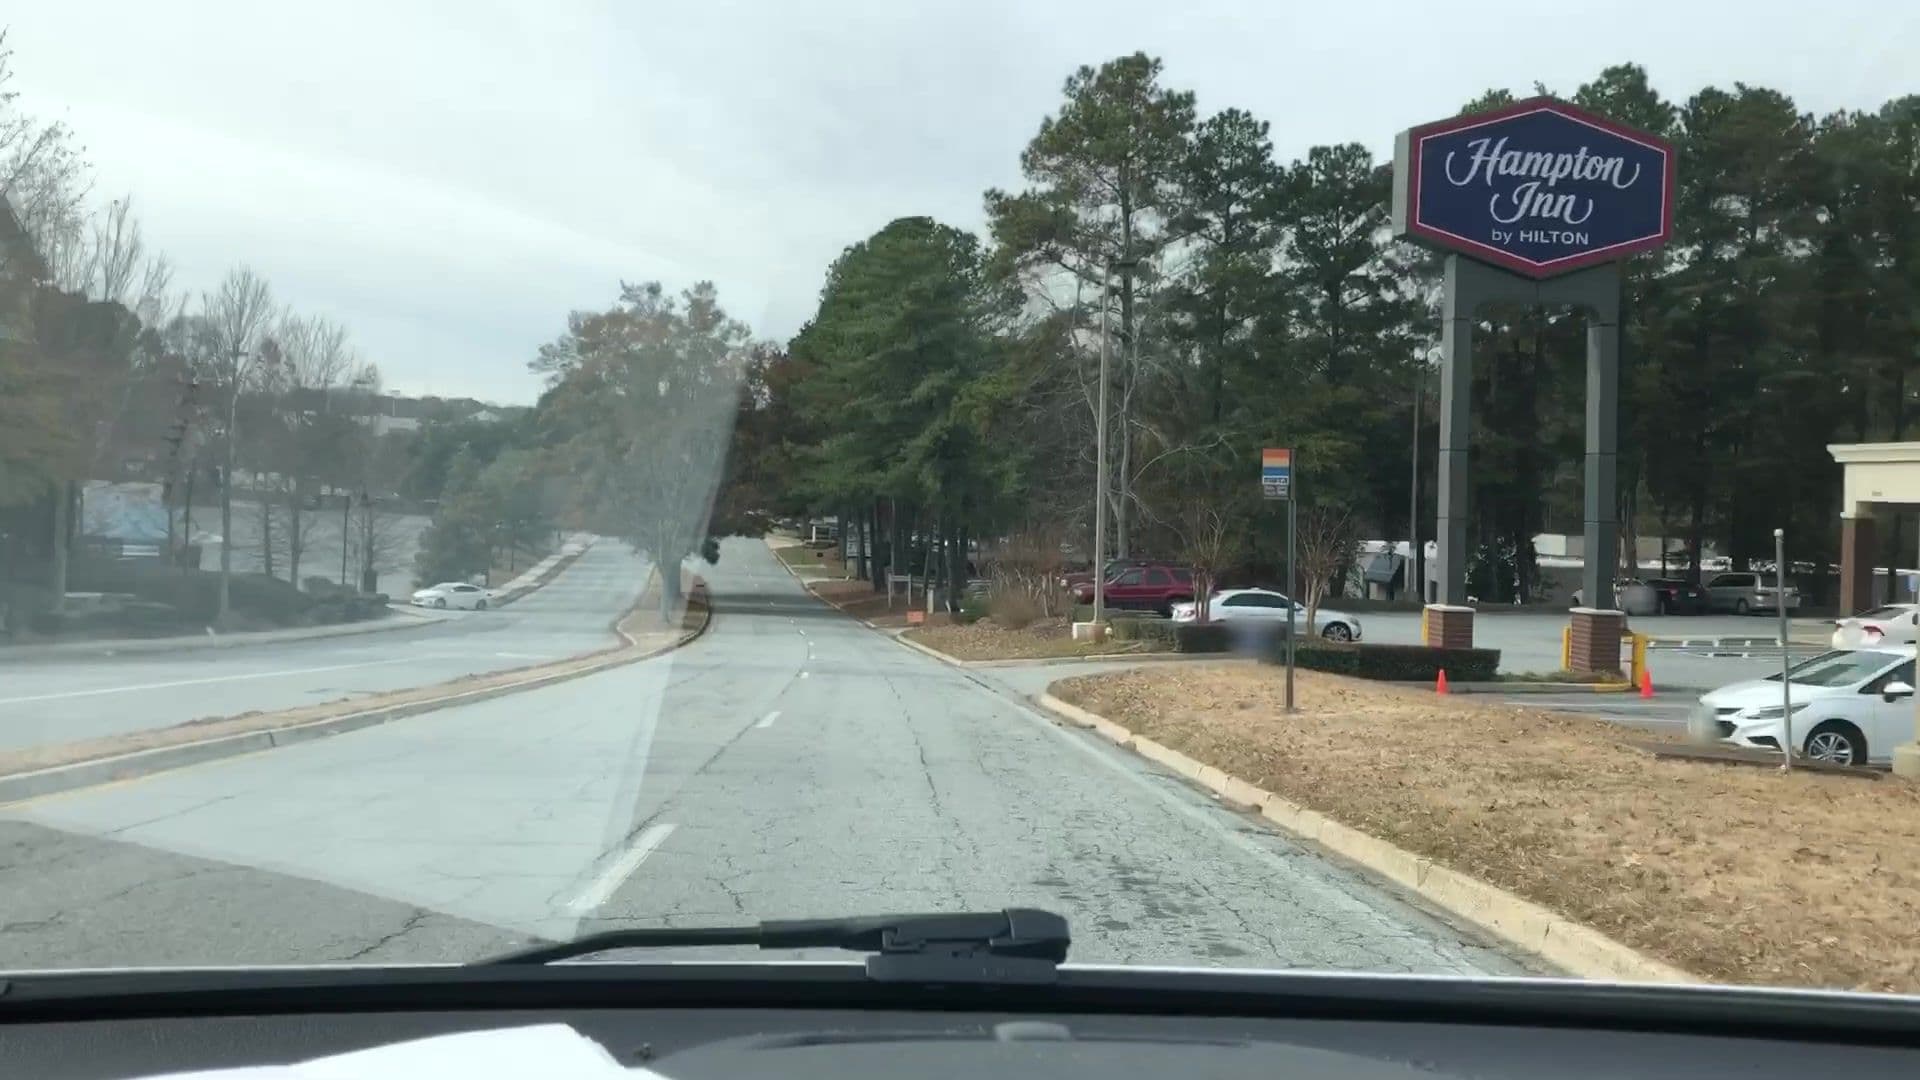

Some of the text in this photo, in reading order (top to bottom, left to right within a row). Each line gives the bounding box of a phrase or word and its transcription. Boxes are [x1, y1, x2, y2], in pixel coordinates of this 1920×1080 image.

[1446, 136, 1640, 189] Hampton
[1490, 182, 1593, 224] Inn
[1492, 229, 1589, 245] by HILTON
